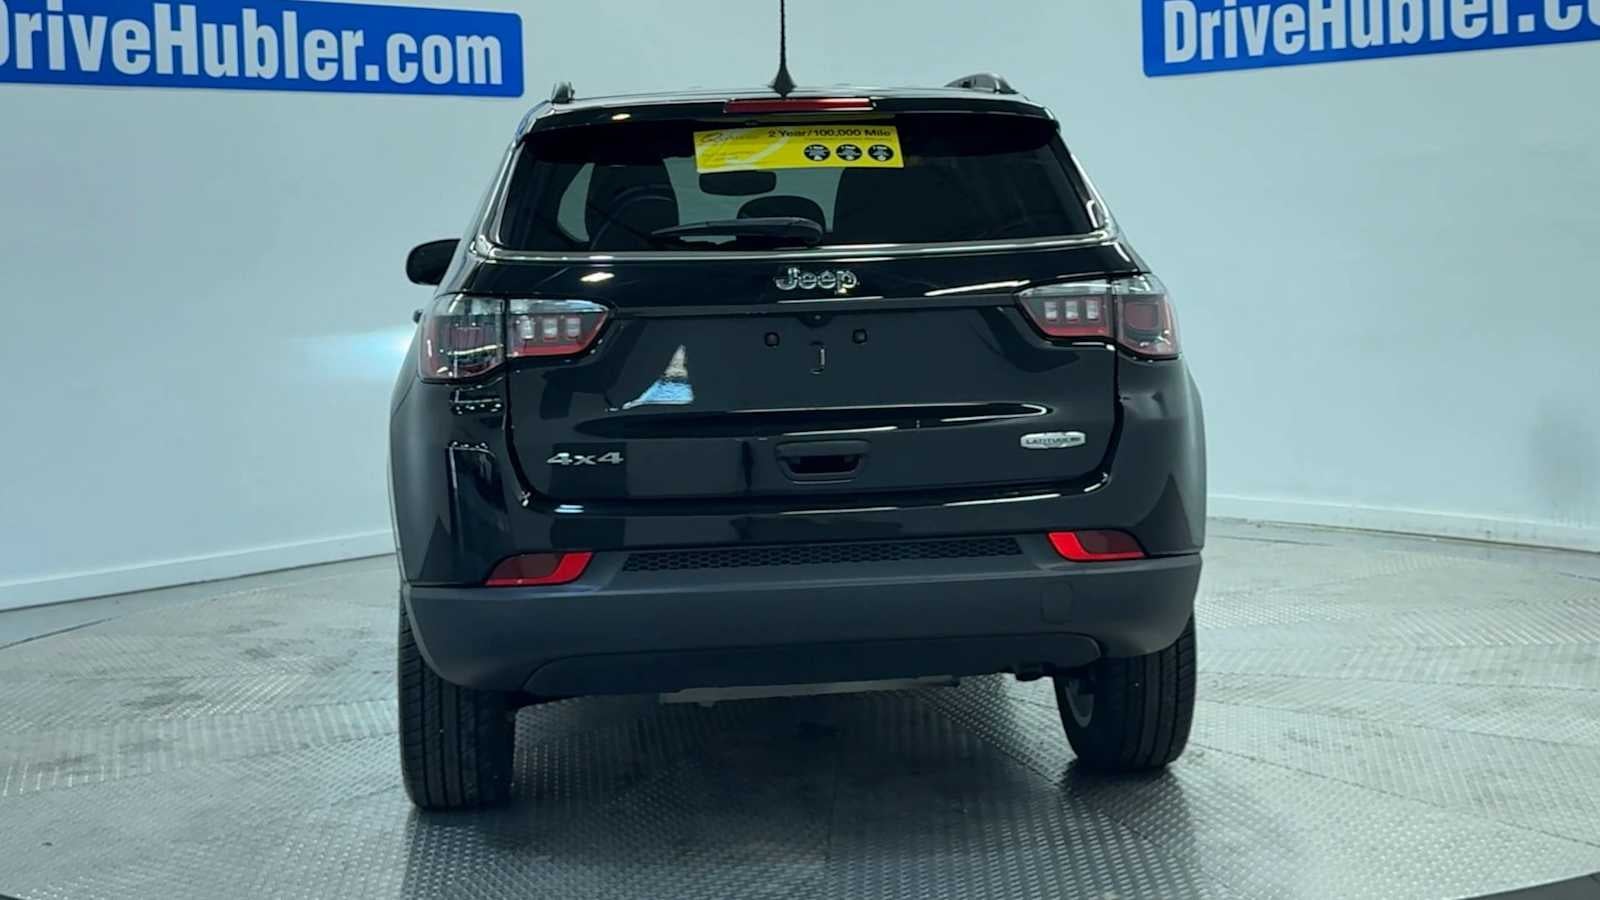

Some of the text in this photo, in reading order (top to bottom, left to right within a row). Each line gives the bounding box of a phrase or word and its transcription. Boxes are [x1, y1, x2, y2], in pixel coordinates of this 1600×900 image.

[0, 0, 503, 85] riveHubler.com
[767, 130, 777, 138] 2
[864, 128, 891, 137] Mile
[775, 266, 858, 293] Jeep
[546, 452, 624, 465] 4x4
